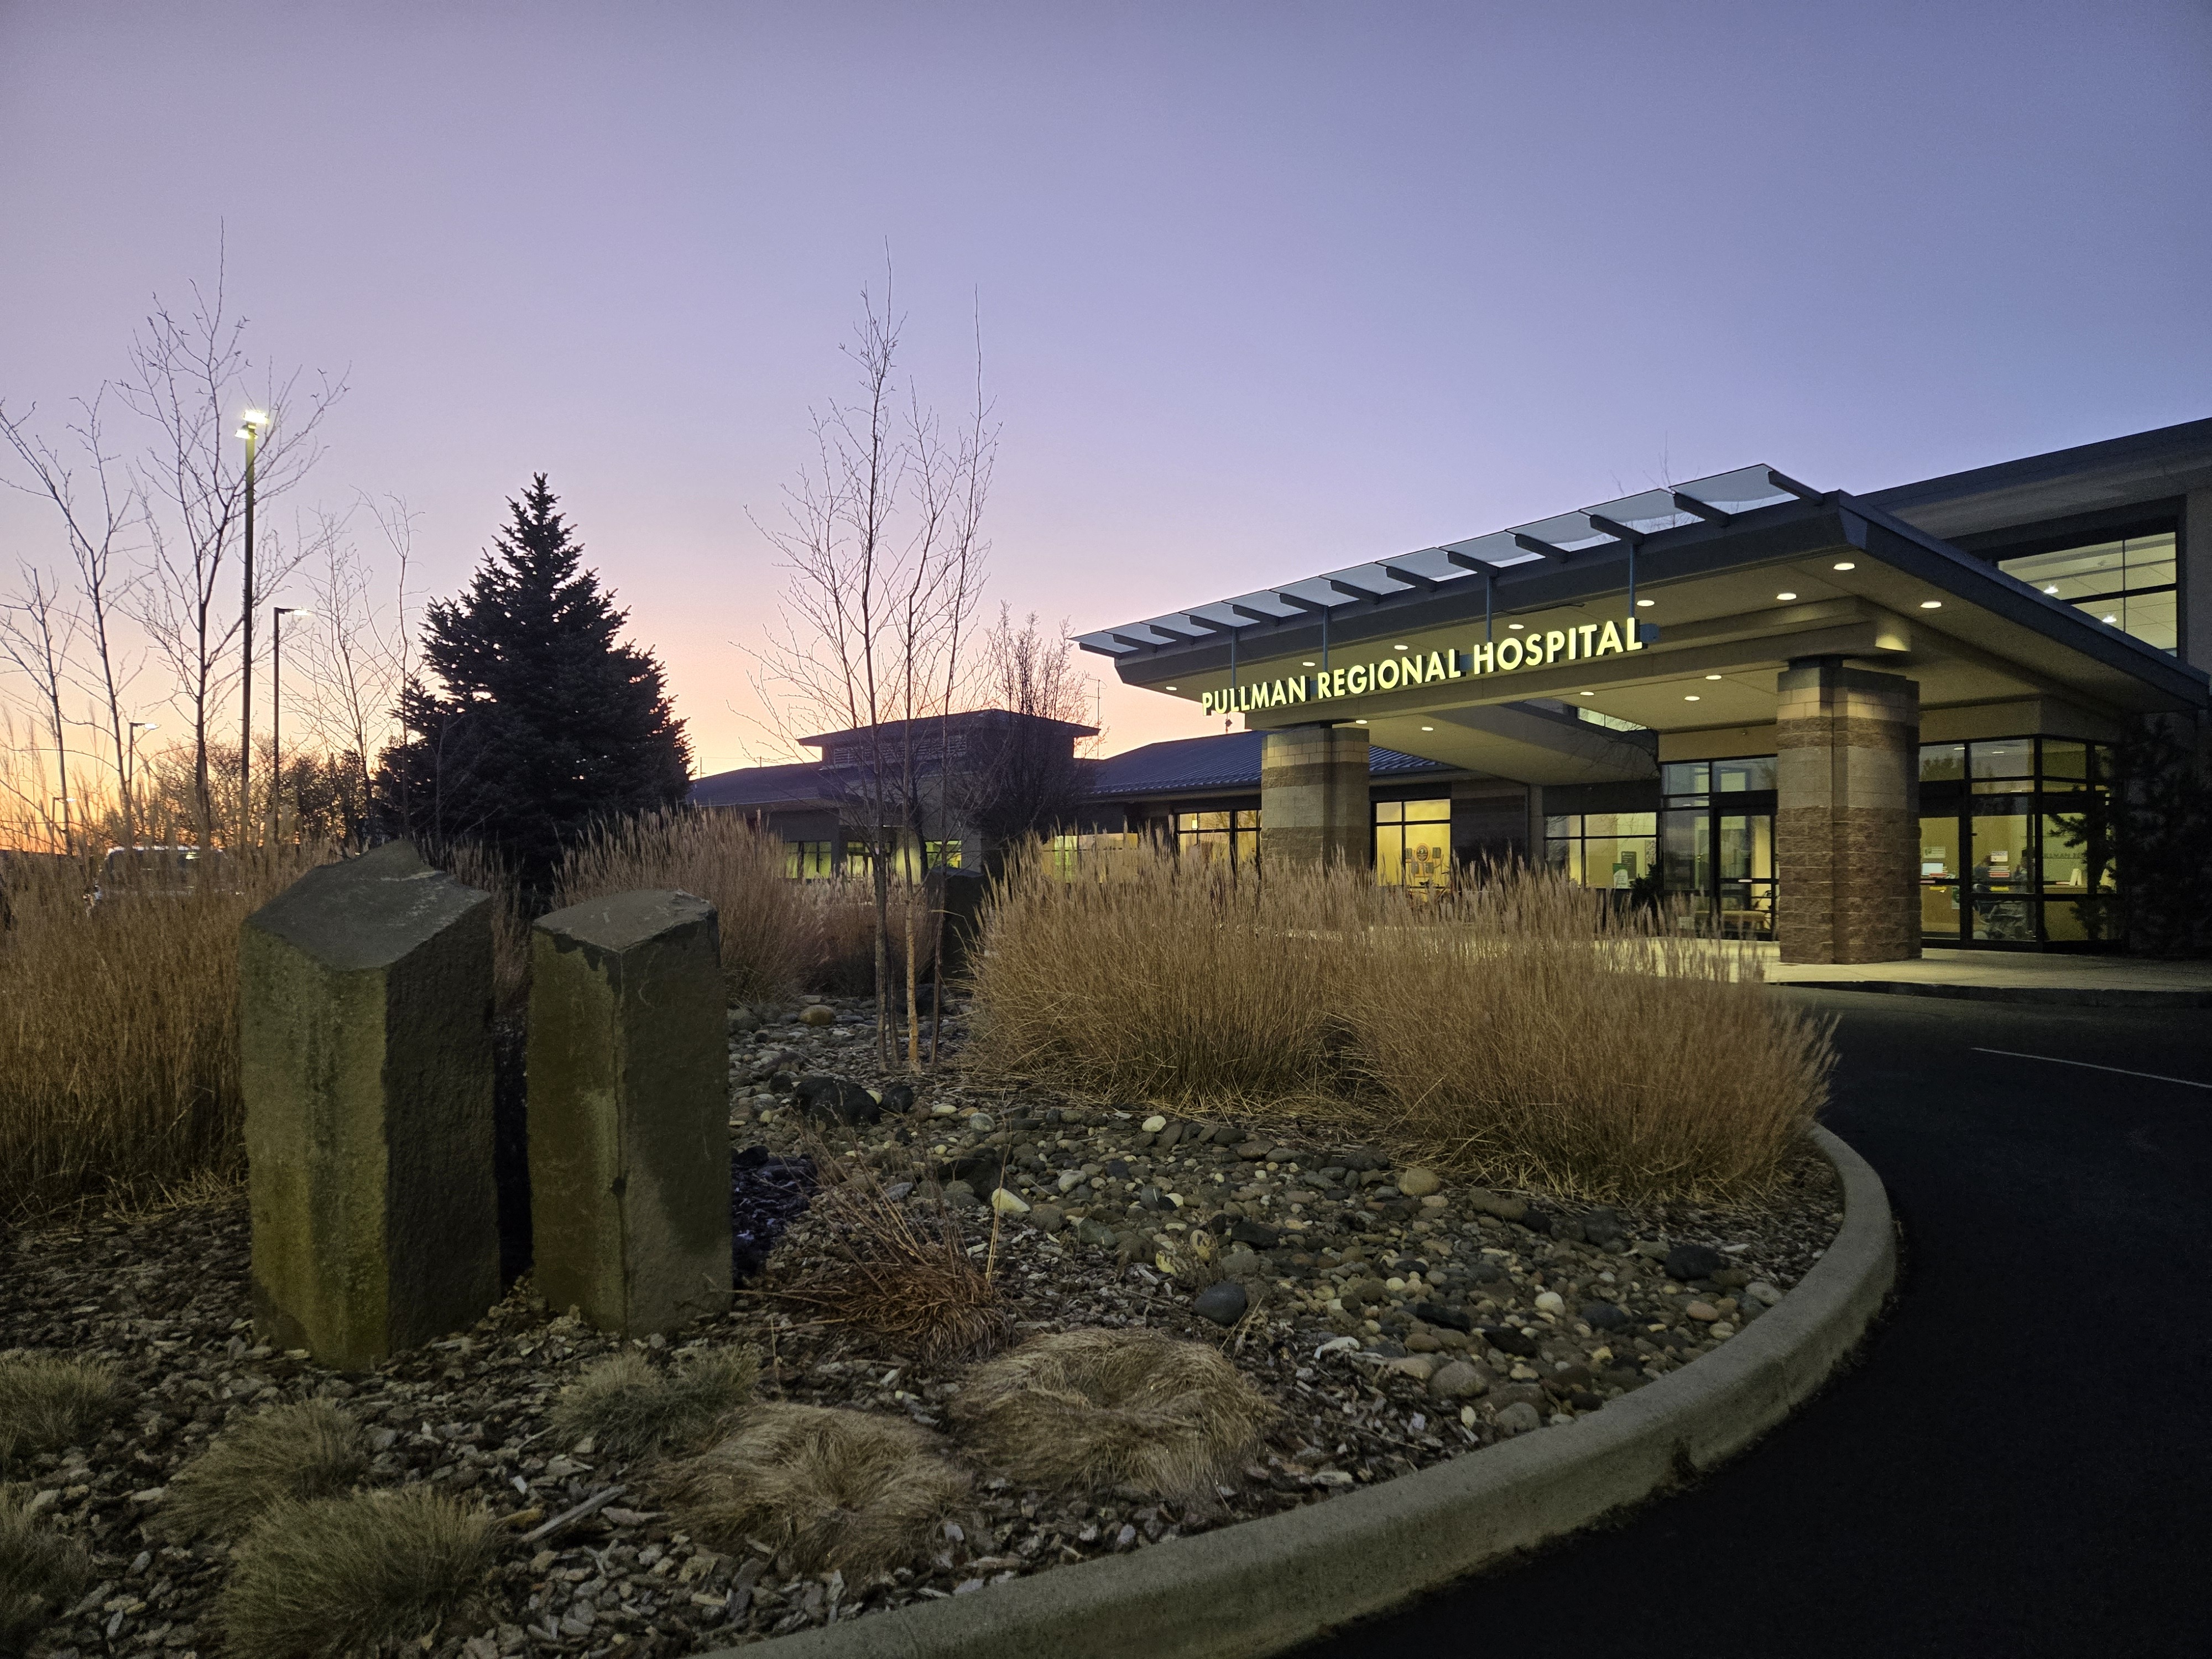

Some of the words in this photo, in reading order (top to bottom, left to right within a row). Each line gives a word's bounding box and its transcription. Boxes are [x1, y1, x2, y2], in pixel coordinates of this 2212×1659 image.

[1202, 675, 1307, 716] PULLMAN
[1317, 648, 1461, 700] REGIONAL
[1474, 617, 1643, 675] HOSPITAL
